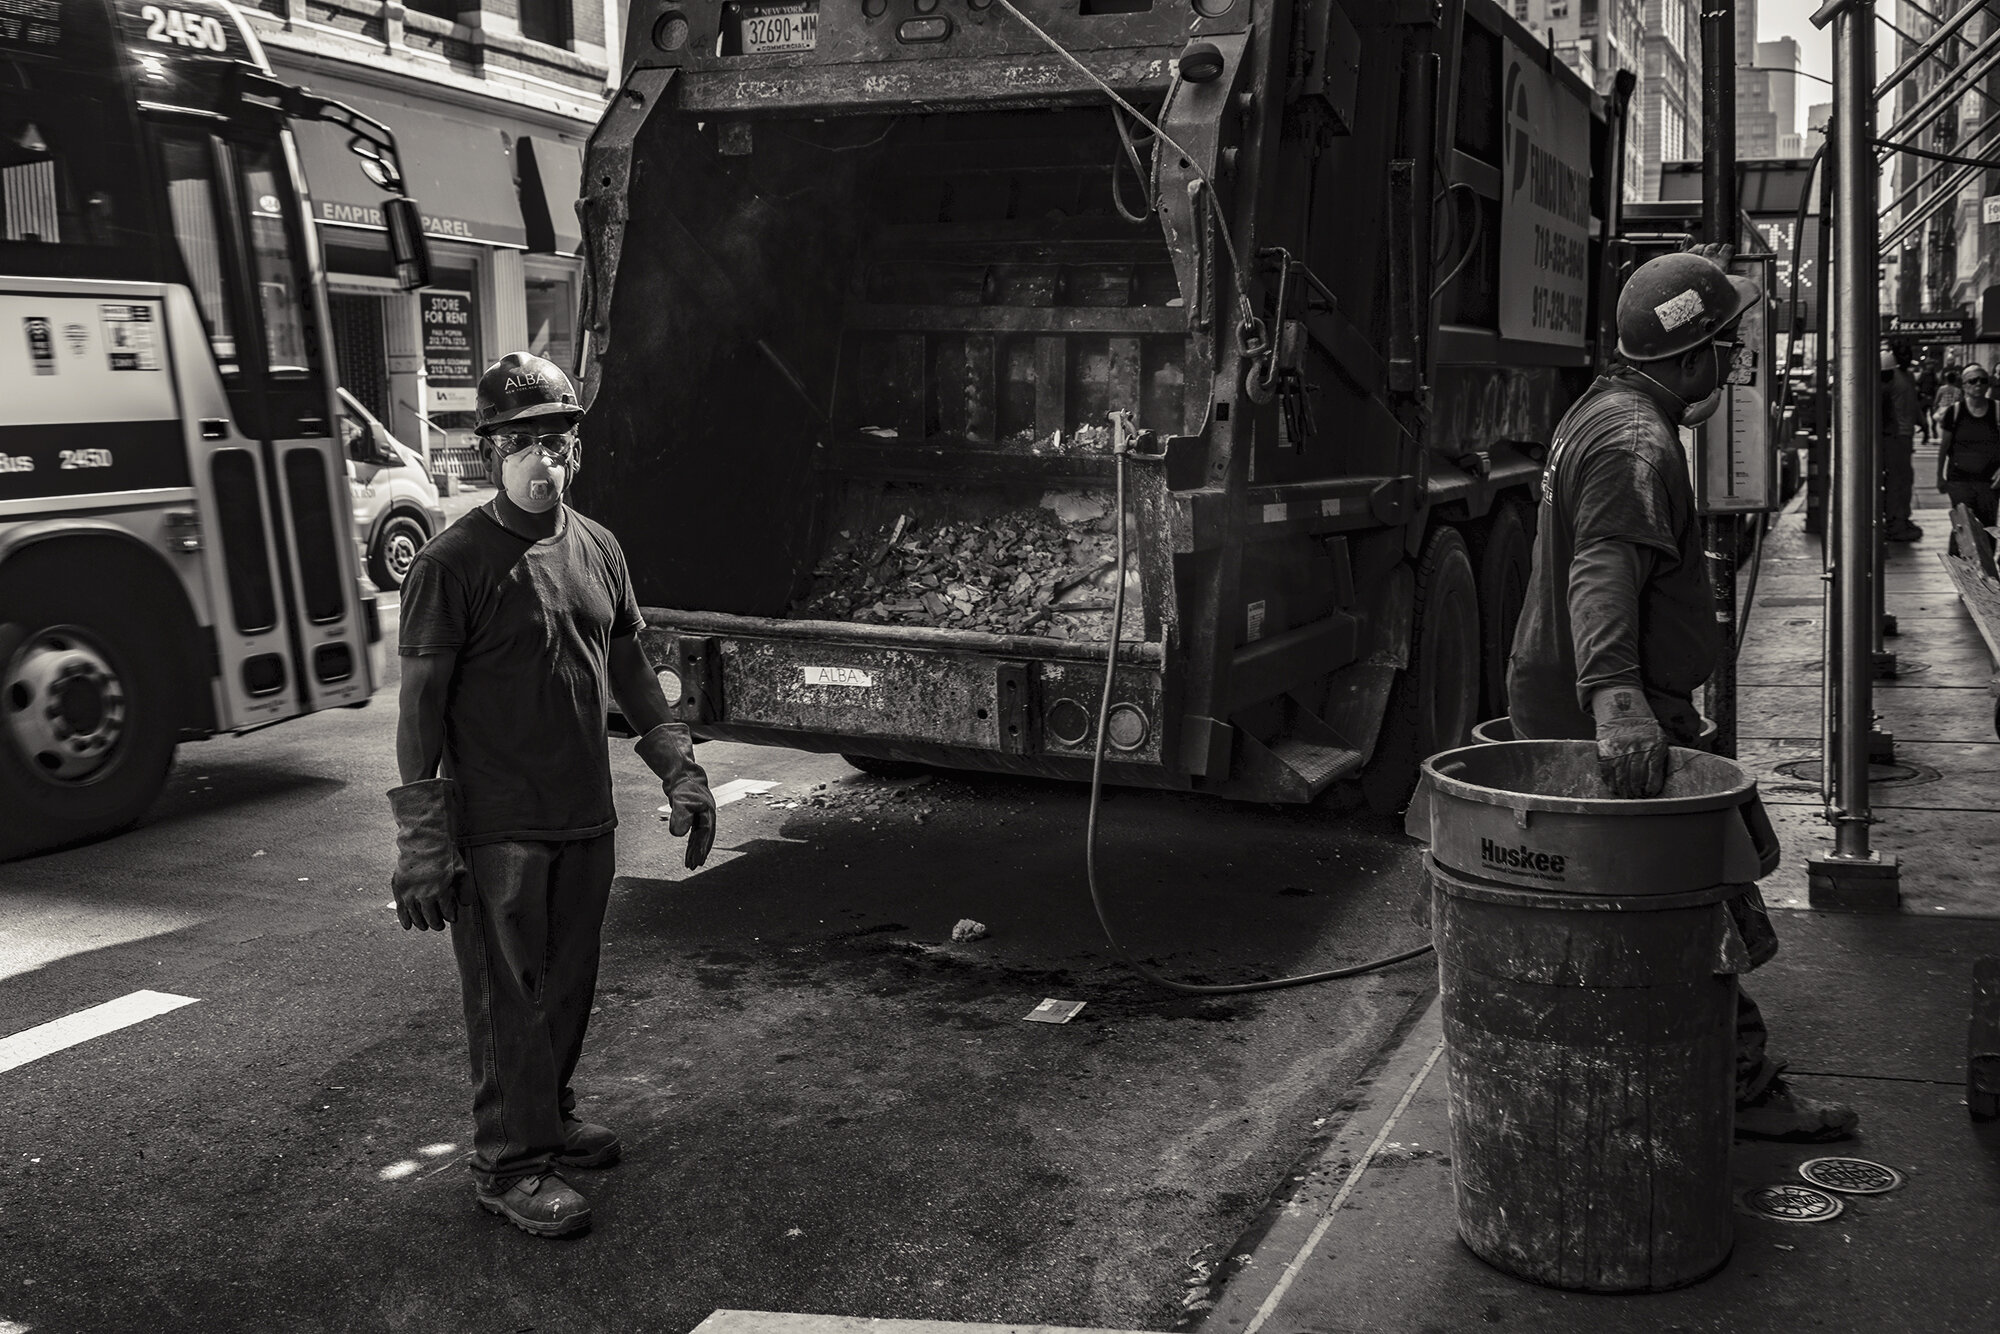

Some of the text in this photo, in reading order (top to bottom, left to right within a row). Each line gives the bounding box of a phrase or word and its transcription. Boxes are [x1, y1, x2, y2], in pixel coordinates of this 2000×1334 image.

[762, 5, 804, 16] NEW YORK
[141, 5, 227, 52] 2450
[761, 43, 806, 52] COMMERCIAL
[322, 203, 473, 237] EMPIR PAREL
[431, 298, 460, 311] STORE
[424, 311, 468, 325] FOR RENT
[505, 372, 549, 390] ALBA
[58, 448, 114, 470] 2450
[819, 667, 859, 683] ALBA
[1481, 837, 1565, 873] Huskee
